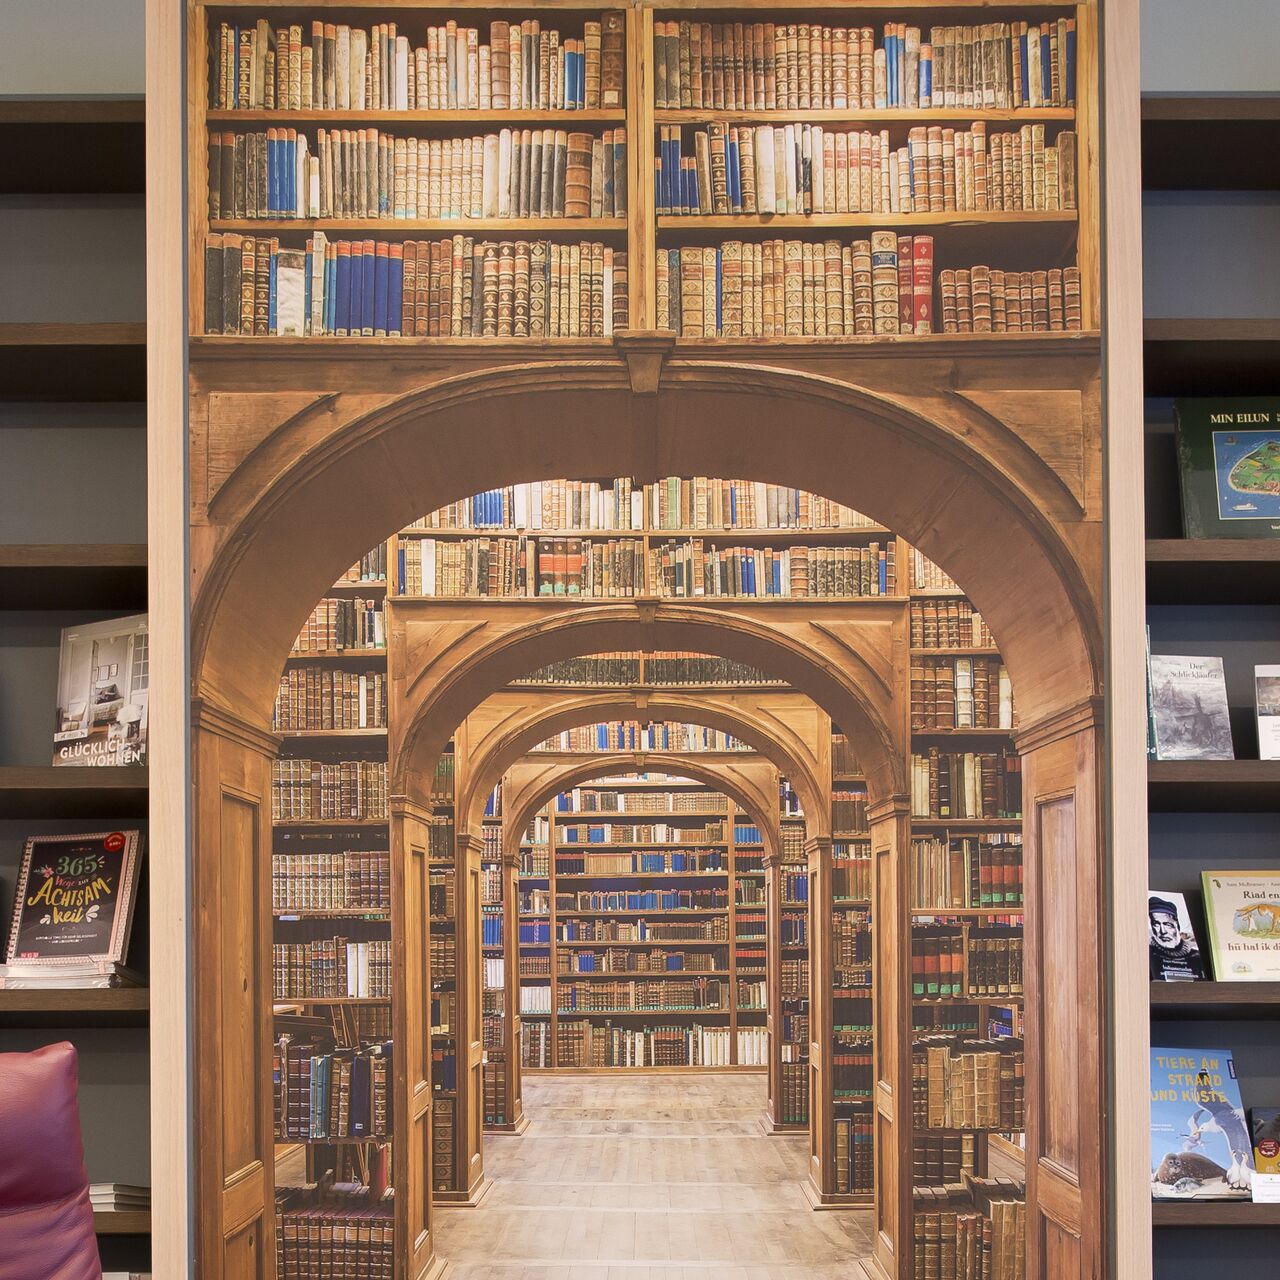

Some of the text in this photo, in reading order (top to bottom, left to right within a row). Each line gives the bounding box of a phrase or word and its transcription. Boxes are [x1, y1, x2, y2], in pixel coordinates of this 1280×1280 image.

[1210, 413, 1270, 424] MIN EILUN
[1188, 662, 1204, 670] Der
[60, 738, 126, 760] GLÜCKLICH
[86, 749, 141, 767] WOHNEN
[56, 854, 98, 876] 365
[1243, 890, 1266, 899] Riad
[53, 906, 84, 925] keit
[1227, 942, 1241, 951] hü
[1261, 942, 1271, 950] ik
[1156, 1056, 1219, 1069] TIERE AN
[1167, 1073, 1223, 1087] STRAND
[1181, 1090, 1228, 1104] KÜSTE
